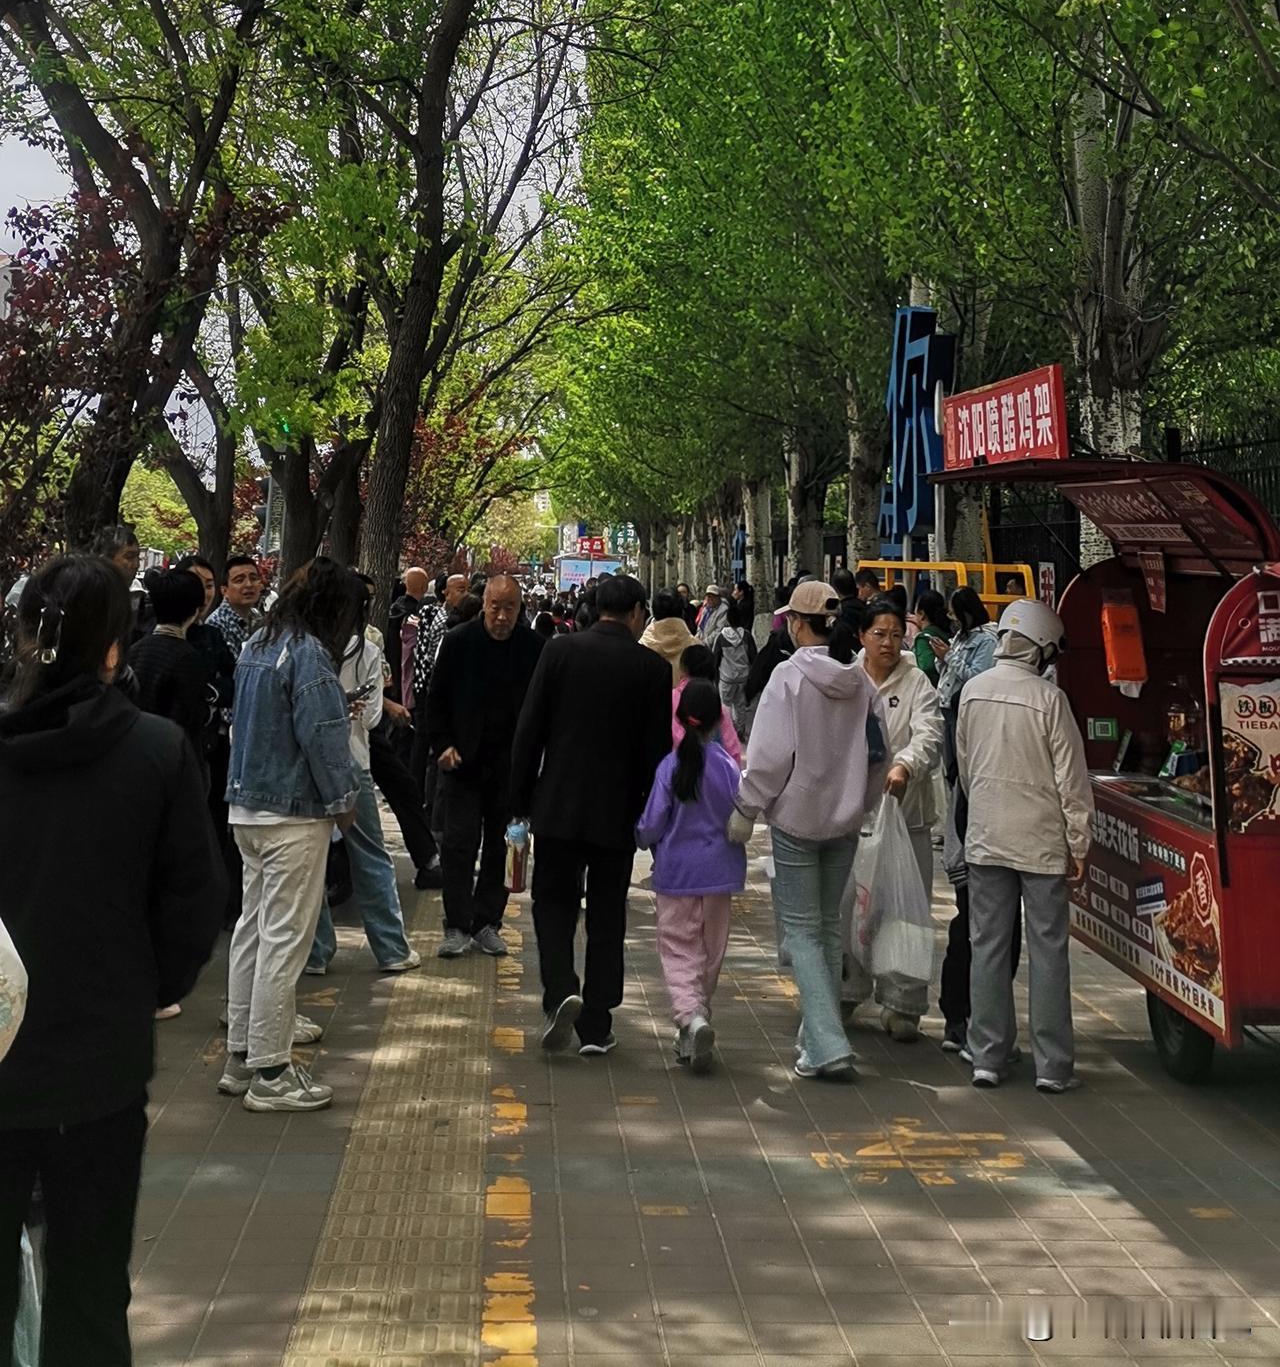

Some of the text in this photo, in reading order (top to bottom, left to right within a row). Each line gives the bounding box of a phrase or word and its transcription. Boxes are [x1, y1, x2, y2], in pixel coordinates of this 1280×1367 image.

[958, 383, 1053, 460] 沈阳喷醋鸡架
